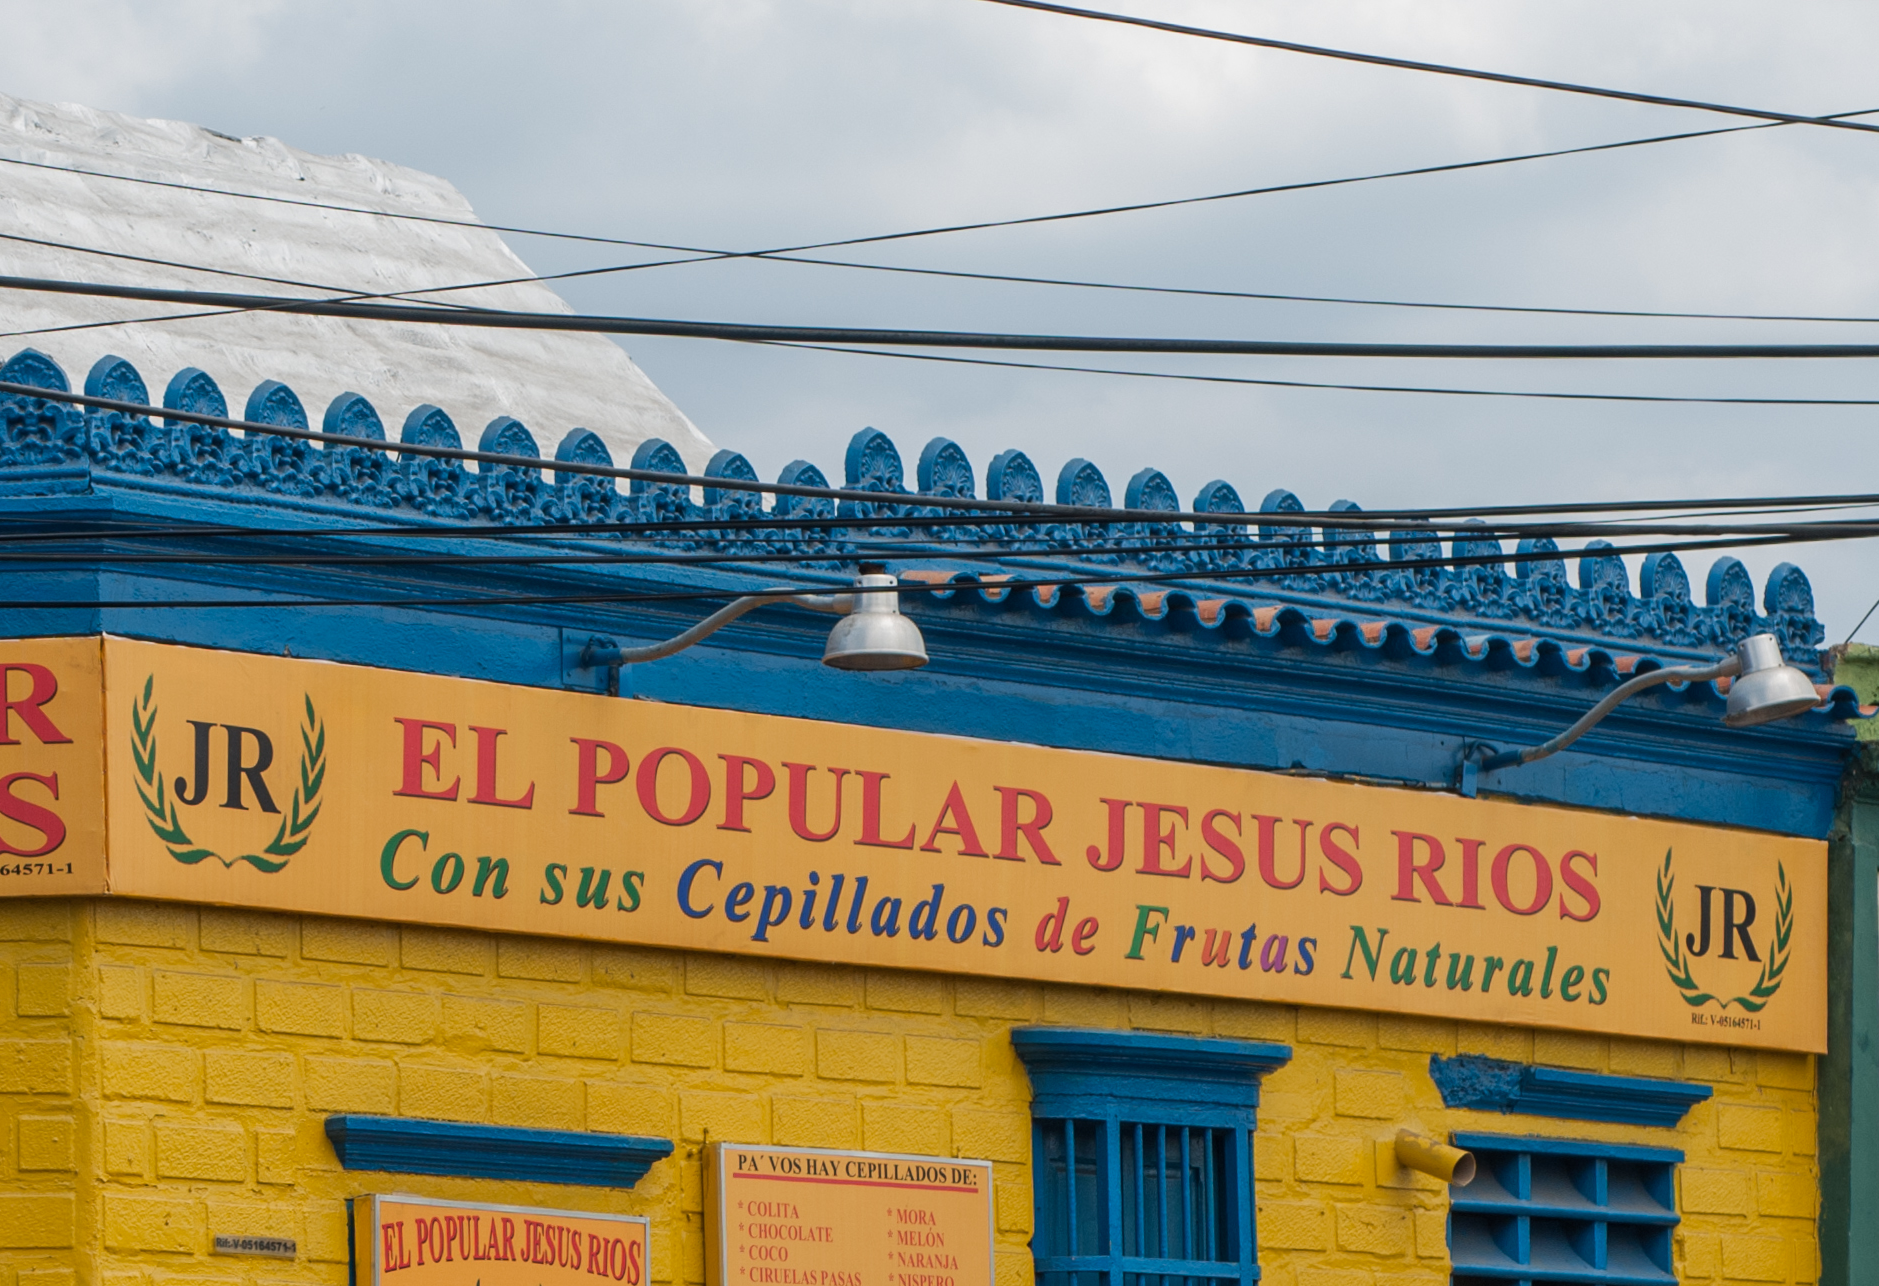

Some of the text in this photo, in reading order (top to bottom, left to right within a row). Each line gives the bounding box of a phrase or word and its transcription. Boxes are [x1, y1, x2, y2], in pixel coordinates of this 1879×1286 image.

[174, 720, 281, 814] JR
[393, 717, 1602, 922] EL POPULAR JESUS RIOS
[380, 829, 1611, 1006] Con sus Cepillados de Frutas Naturales
[1686, 884, 1760, 962] JR
[1710, 1014, 1761, 1030] V-05164571-1
[768, 1156, 802, 1175] VOS
[806, 1158, 841, 1177] HAY
[845, 1160, 947, 1184] CEPILLADOS
[951, 1168, 978, 1186] DE:
[747, 1200, 800, 1220] COLITA
[896, 1208, 936, 1227] MORA
[748, 1223, 834, 1243] CHOCOLATE
[897, 1227, 945, 1248] MELÓN
[382, 1215, 641, 1286] EL POPULAR JESUS RIOS
[748, 1244, 789, 1263] COCO
[897, 1251, 959, 1271] NARANJA
[749, 1267, 817, 1286] CIRUELAS
